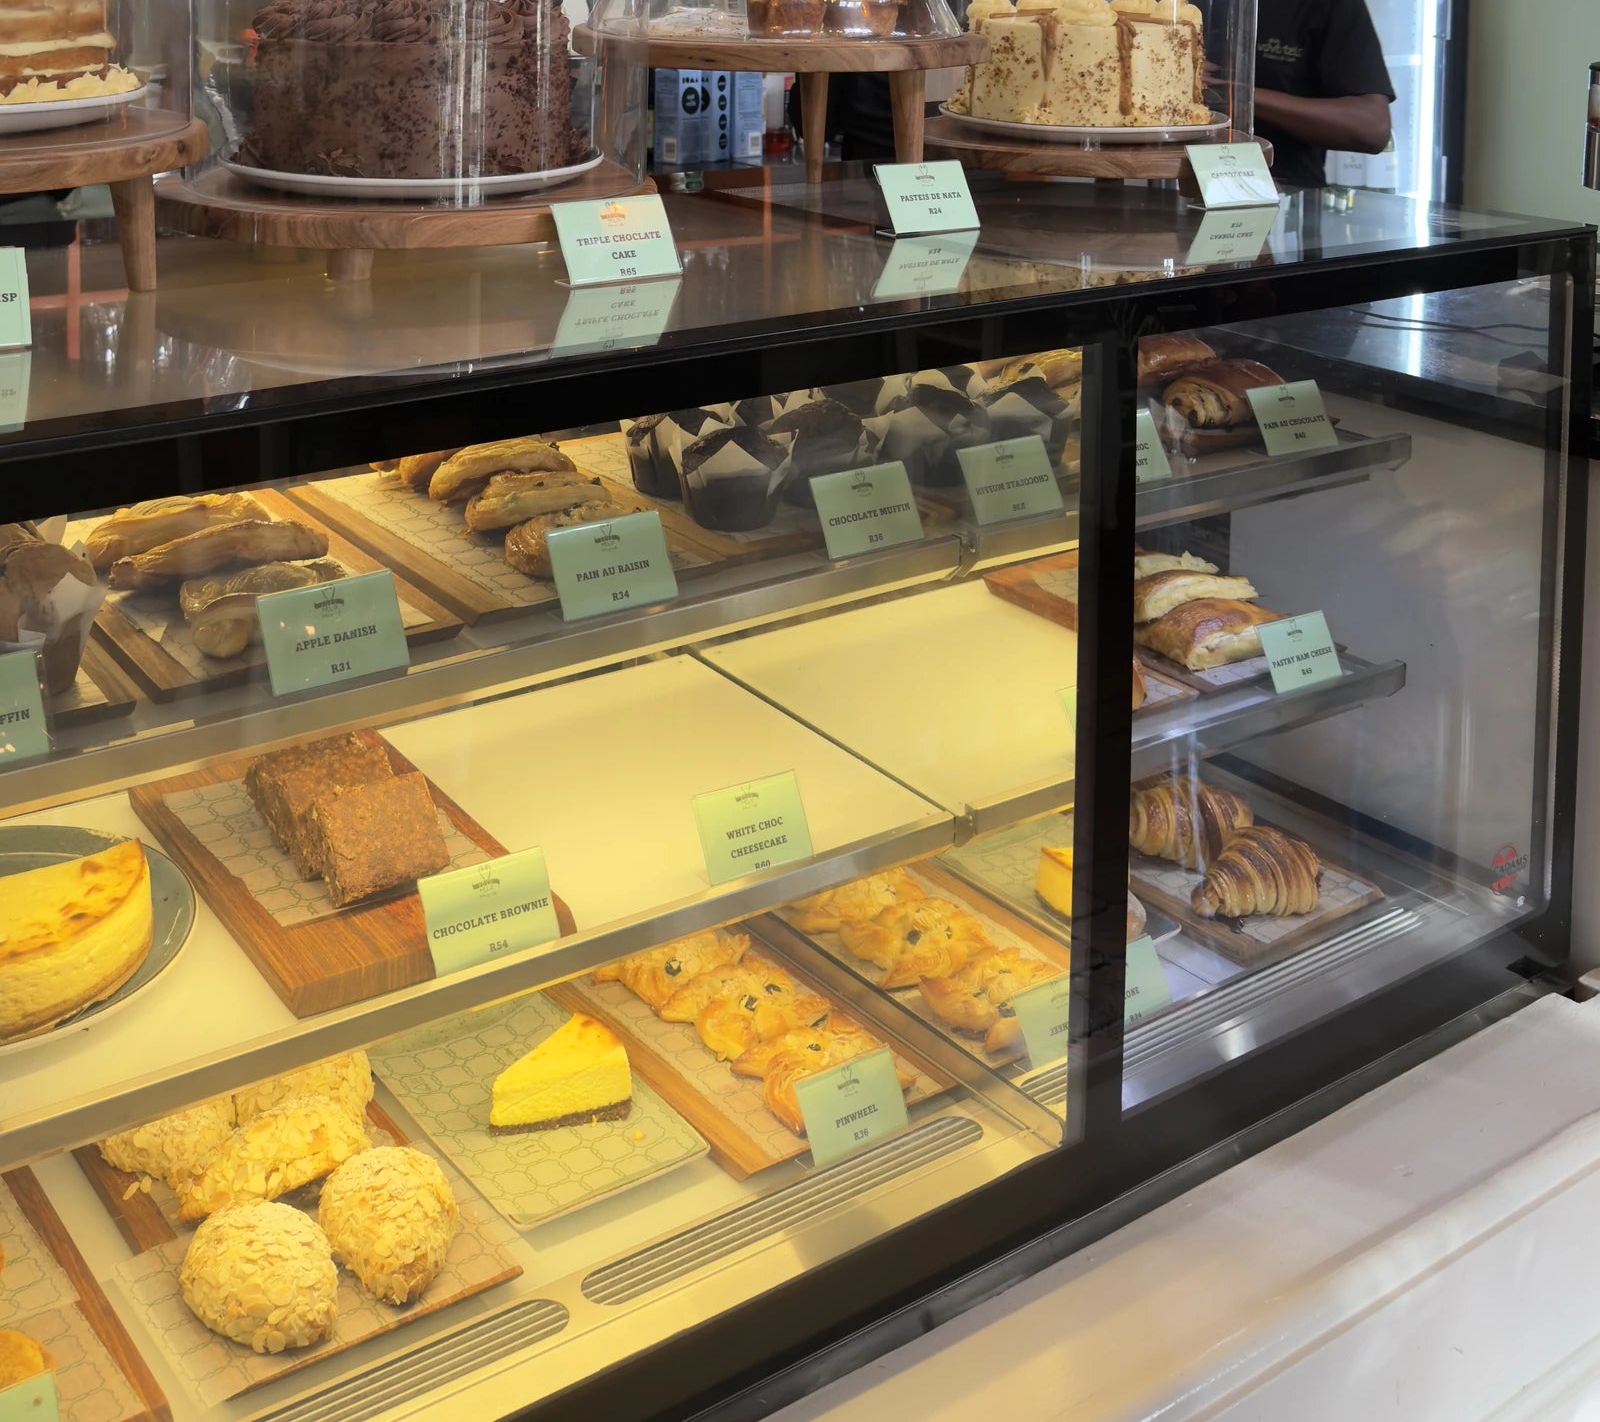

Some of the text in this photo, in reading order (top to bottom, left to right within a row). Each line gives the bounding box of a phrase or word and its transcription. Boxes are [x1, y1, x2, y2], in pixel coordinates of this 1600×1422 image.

[900, 193, 929, 202] PASTEIS
[943, 191, 961, 199] NATA
[928, 207, 942, 215] R24
[577, 231, 661, 246] TRIPLE CHOCLATE
[612, 250, 637, 260] CAKE
[620, 267, 637, 277] R65
[1264, 421, 1279, 429] PAIN
[1289, 415, 1325, 426] CHOCOLATE
[829, 502, 910, 527] CHOCOLATE MUFFIN
[868, 533, 884, 543] R36
[576, 560, 650, 582] PAIN AU RAISIN
[612, 590, 629, 601] R34
[295, 625, 377, 652] APPLE DANISH
[1272, 646, 1332, 668] PASTRY HAM CHEESE
[331, 661, 351, 674] R31
[726, 816, 783, 840] WHITE CHOC
[731, 834, 788, 858] CHEESECAKE
[755, 859, 771, 870] R60
[433, 897, 549, 939] CHOCOLATE BROWNIE
[489, 939, 509, 952] R54
[835, 1104, 878, 1128] PINWHEEL
[853, 1128, 869, 1141] R36
